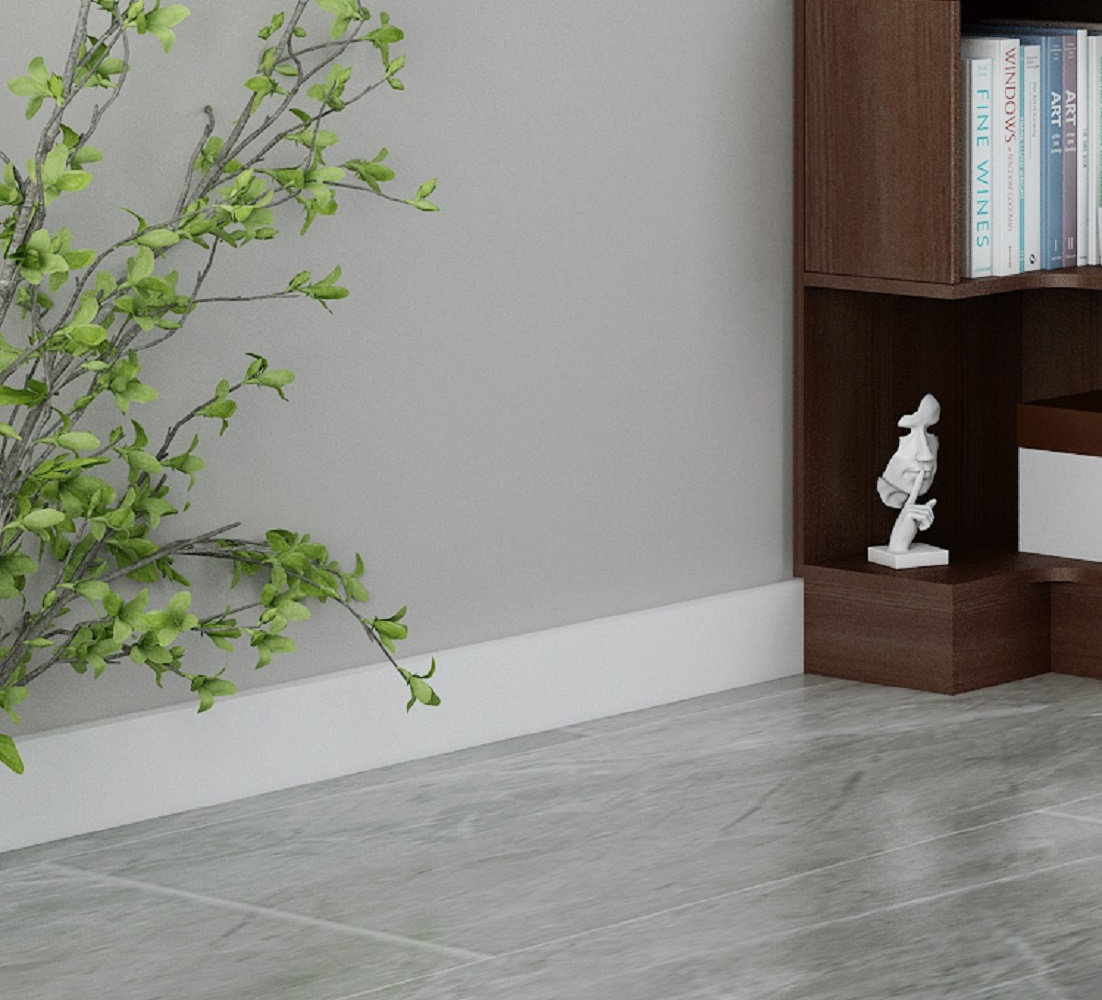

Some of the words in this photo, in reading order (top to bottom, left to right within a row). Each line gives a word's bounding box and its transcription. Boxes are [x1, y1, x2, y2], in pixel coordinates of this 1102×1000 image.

[976, 89, 990, 147] FINE
[1004, 47, 1017, 143] WINDOWS
[1051, 91, 1062, 127] ART
[1065, 89, 1076, 126] ART
[976, 159, 990, 248] WINES
